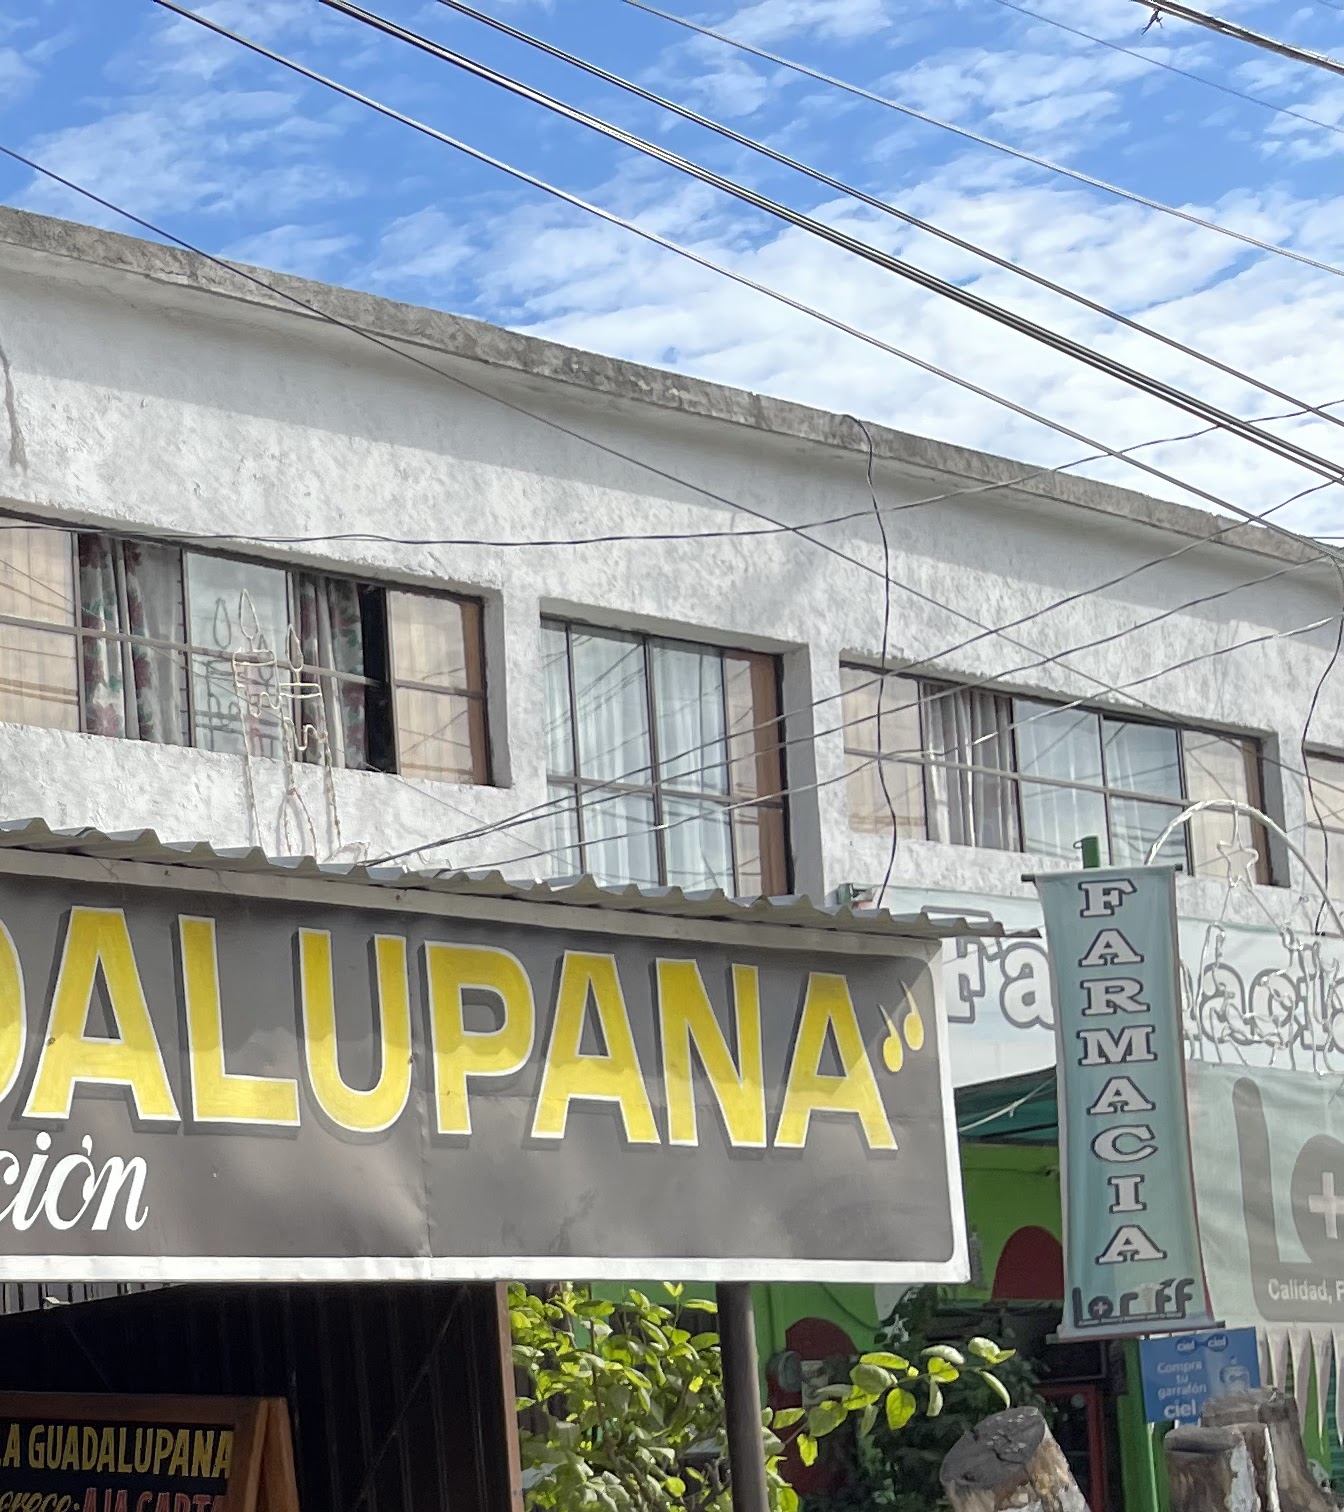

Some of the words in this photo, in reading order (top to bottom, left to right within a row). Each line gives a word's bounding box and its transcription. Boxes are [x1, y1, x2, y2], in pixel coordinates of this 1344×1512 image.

[1077, 878, 1168, 1266] FARMACIA
[1268, 1278, 1333, 1304] Calidad,
[1156, 1360, 1203, 1374] Compra
[1163, 1399, 1198, 1419] ciel
[28, 1424, 234, 1479] GUADALUPANA
